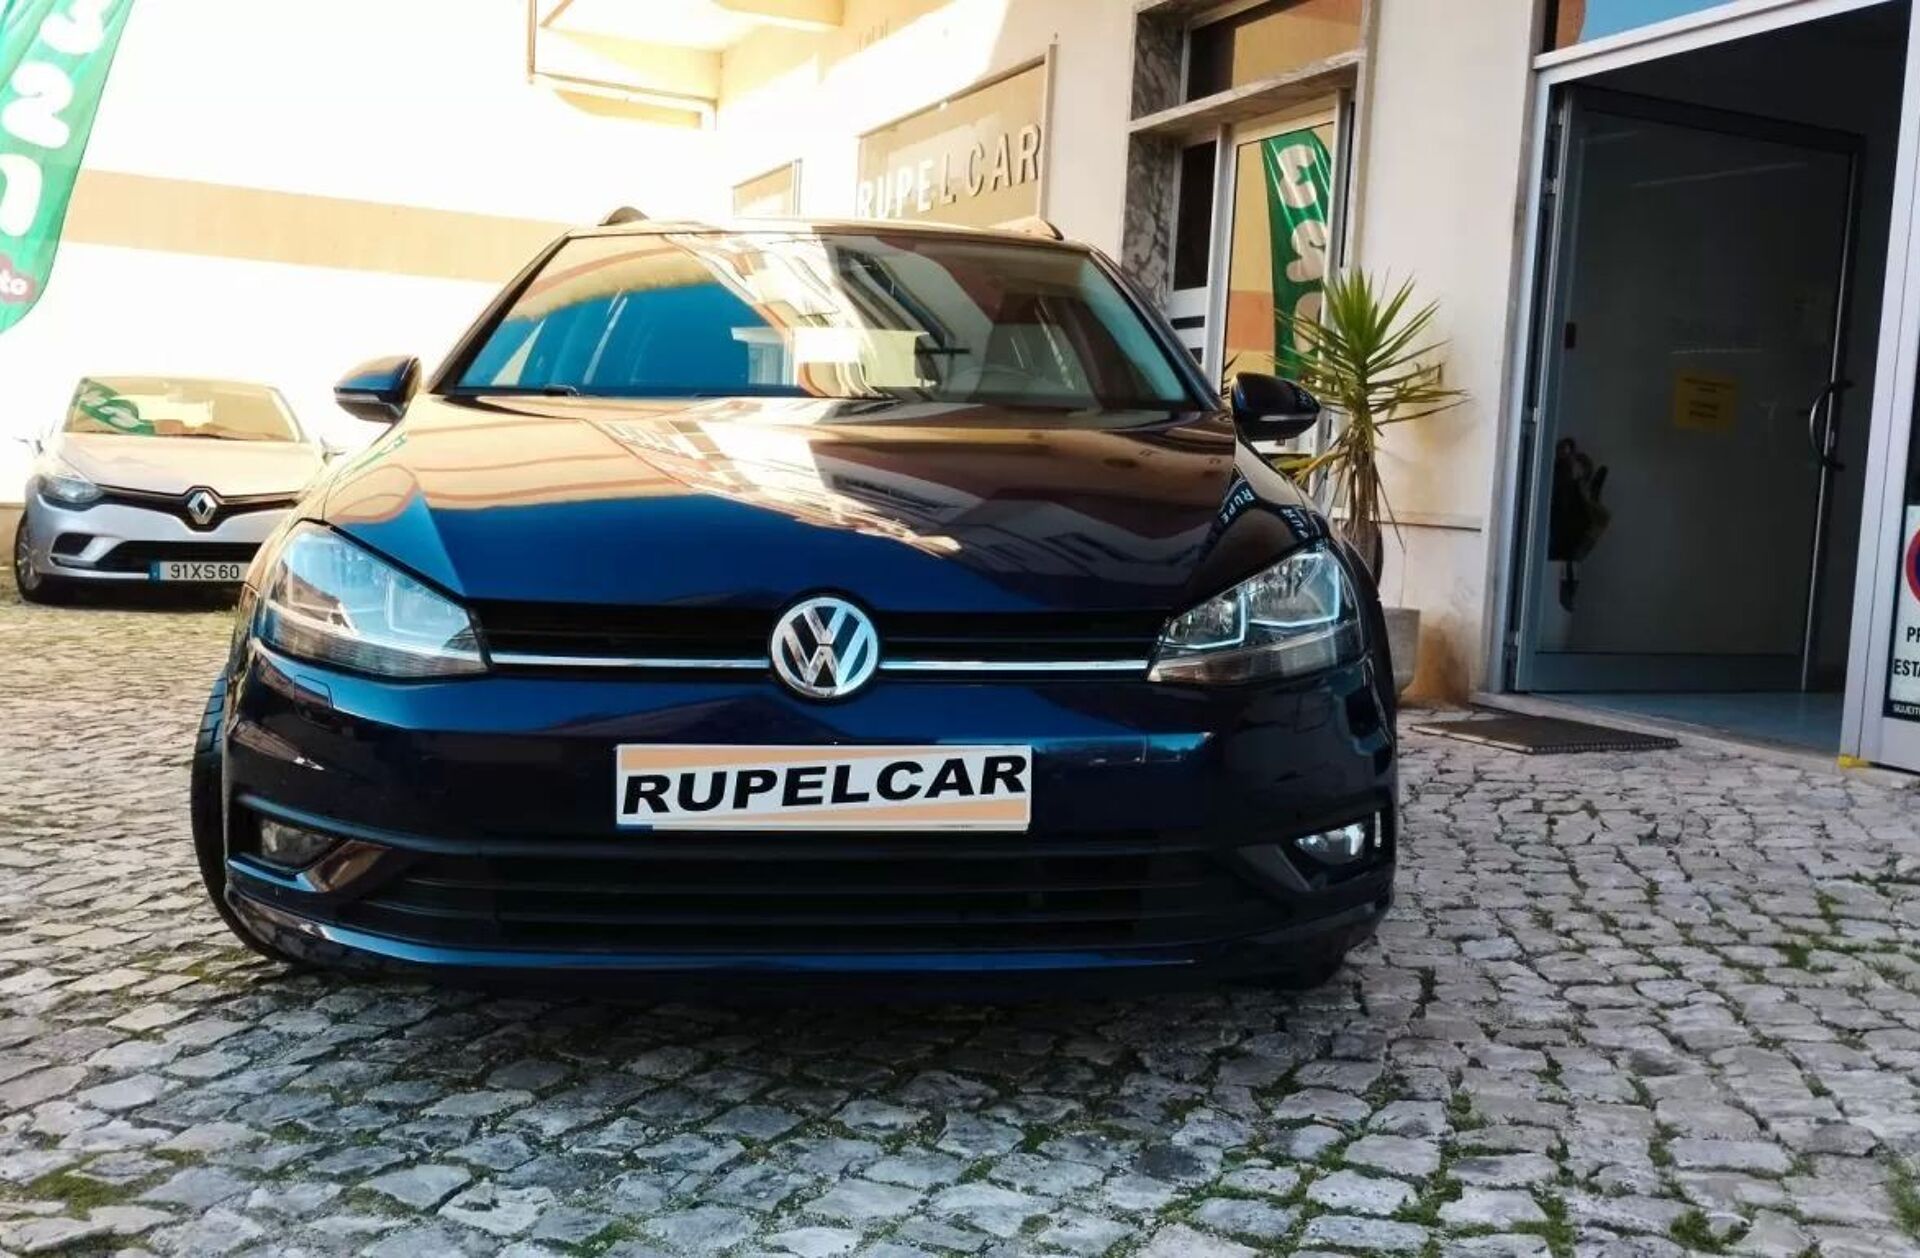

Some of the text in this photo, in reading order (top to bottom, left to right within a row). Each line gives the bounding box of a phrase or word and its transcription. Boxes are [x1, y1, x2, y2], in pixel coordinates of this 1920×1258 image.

[170, 564, 240, 579] 91XS60
[1893, 658, 1920, 678] EST
[622, 755, 1027, 815] RUPELCAR
